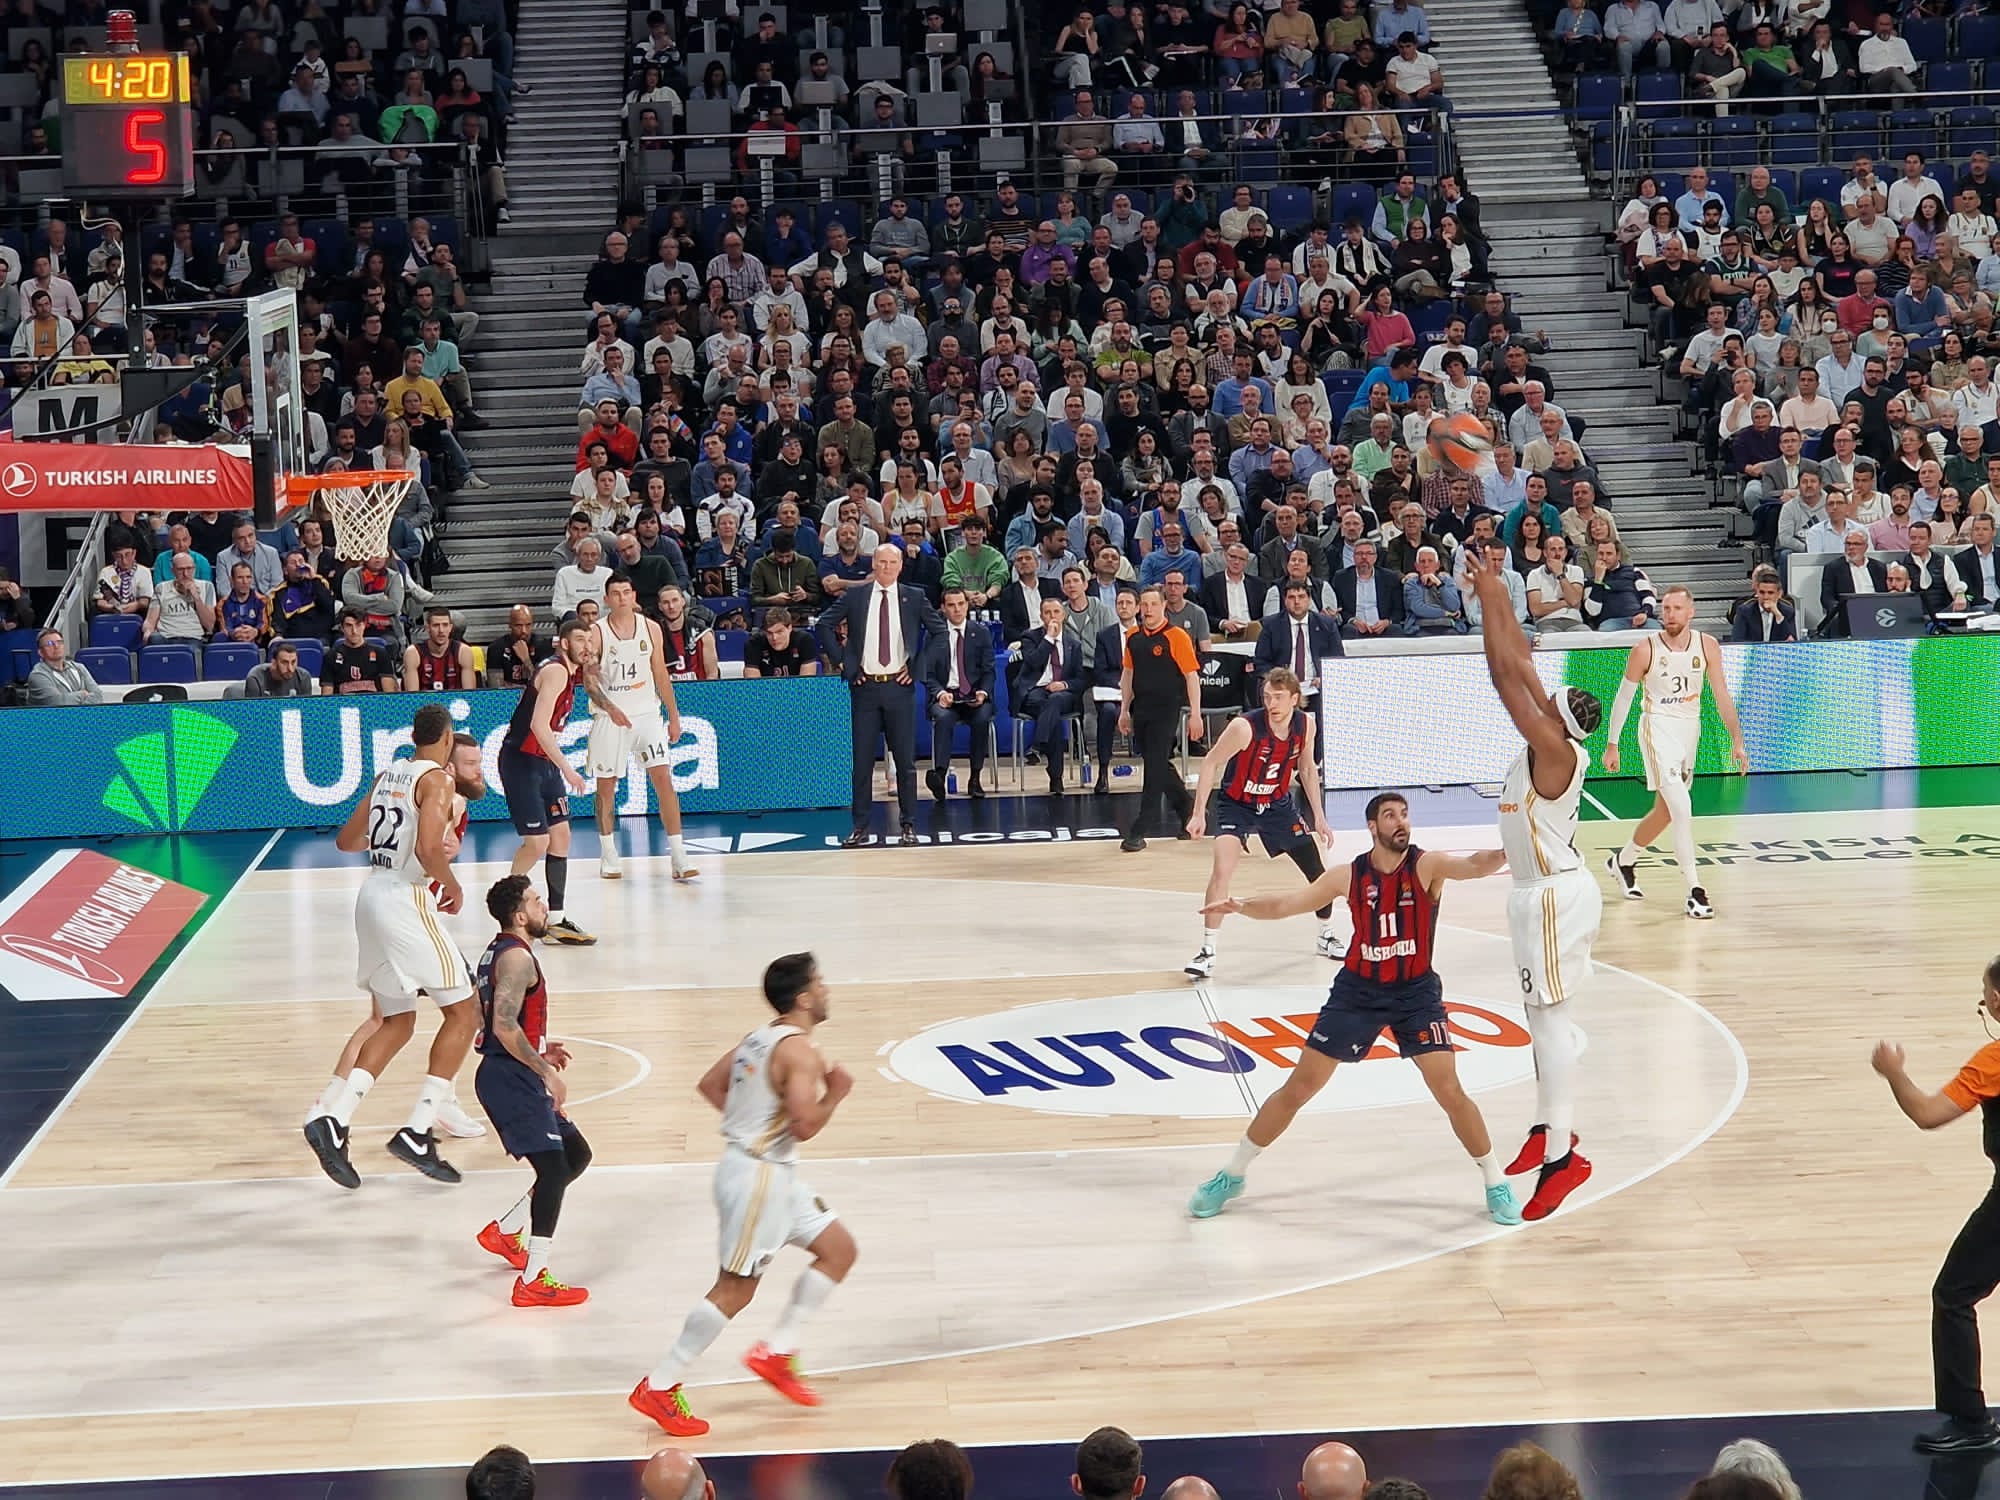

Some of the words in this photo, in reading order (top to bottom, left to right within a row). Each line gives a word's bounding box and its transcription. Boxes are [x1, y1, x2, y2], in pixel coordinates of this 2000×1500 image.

[88, 60, 172, 99] 4:20
[126, 110, 167, 184] 5
[38, 396, 99, 443] M
[45, 470, 127, 486] TURKISH
[133, 469, 217, 485] AIRLINES
[621, 662, 637, 681] 14
[1200, 675, 1231, 687] nicaja
[1671, 676, 1689, 694] 31
[648, 743, 665, 760] 14
[1266, 762, 1281, 780] 2
[369, 804, 404, 851] 22
[51, 901, 133, 955] TURKISH
[92, 865, 167, 917] AIRLINES
[1378, 912, 1398, 939] 11
[1520, 966, 1533, 995] 8
[935, 1001, 1532, 1097] AUTOHO
